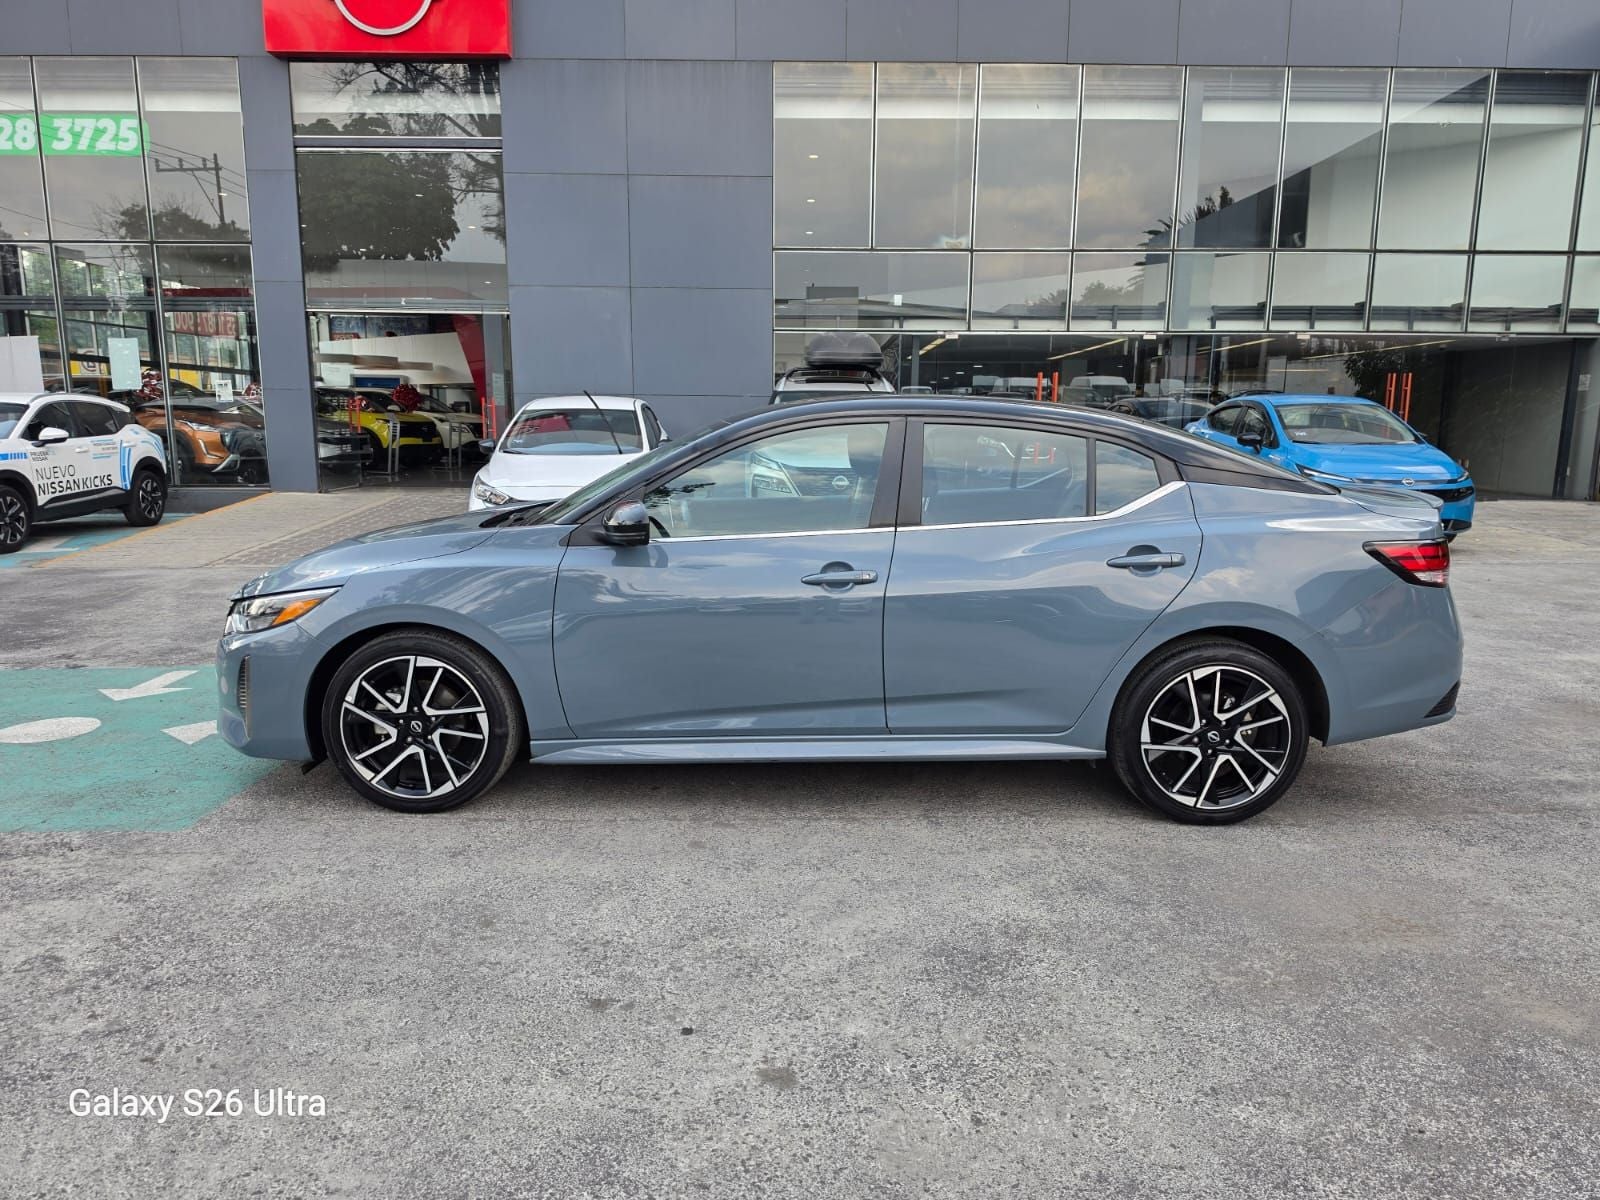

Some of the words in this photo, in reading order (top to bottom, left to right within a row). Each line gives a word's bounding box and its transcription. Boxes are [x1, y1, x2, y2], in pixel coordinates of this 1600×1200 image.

[0, 117, 36, 151] 28
[51, 118, 139, 151] 3725
[35, 464, 75, 481] NUEVO
[37, 478, 80, 496] NISSAN
[82, 474, 113, 490] KICKS
